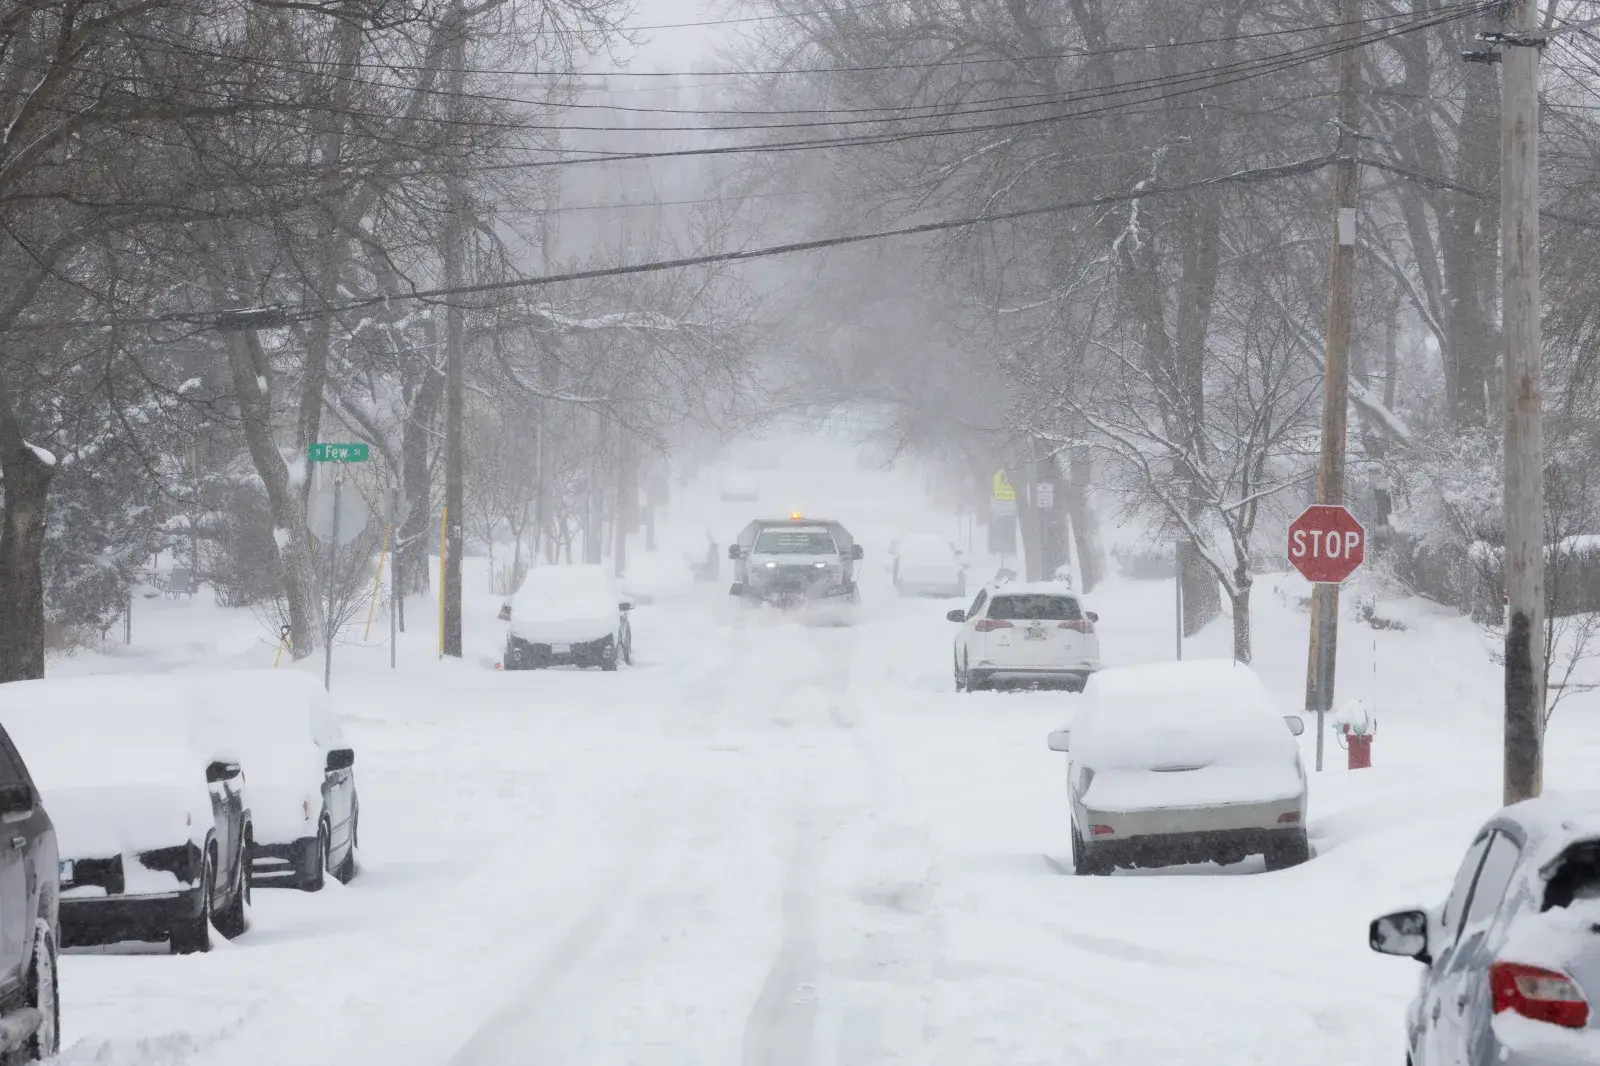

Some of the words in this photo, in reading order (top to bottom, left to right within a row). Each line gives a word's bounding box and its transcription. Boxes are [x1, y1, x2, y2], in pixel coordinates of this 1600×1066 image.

[315, 448, 321, 456] N
[325, 445, 348, 458] Few
[353, 448, 361, 456] St
[1291, 529, 1360, 559] STOP
